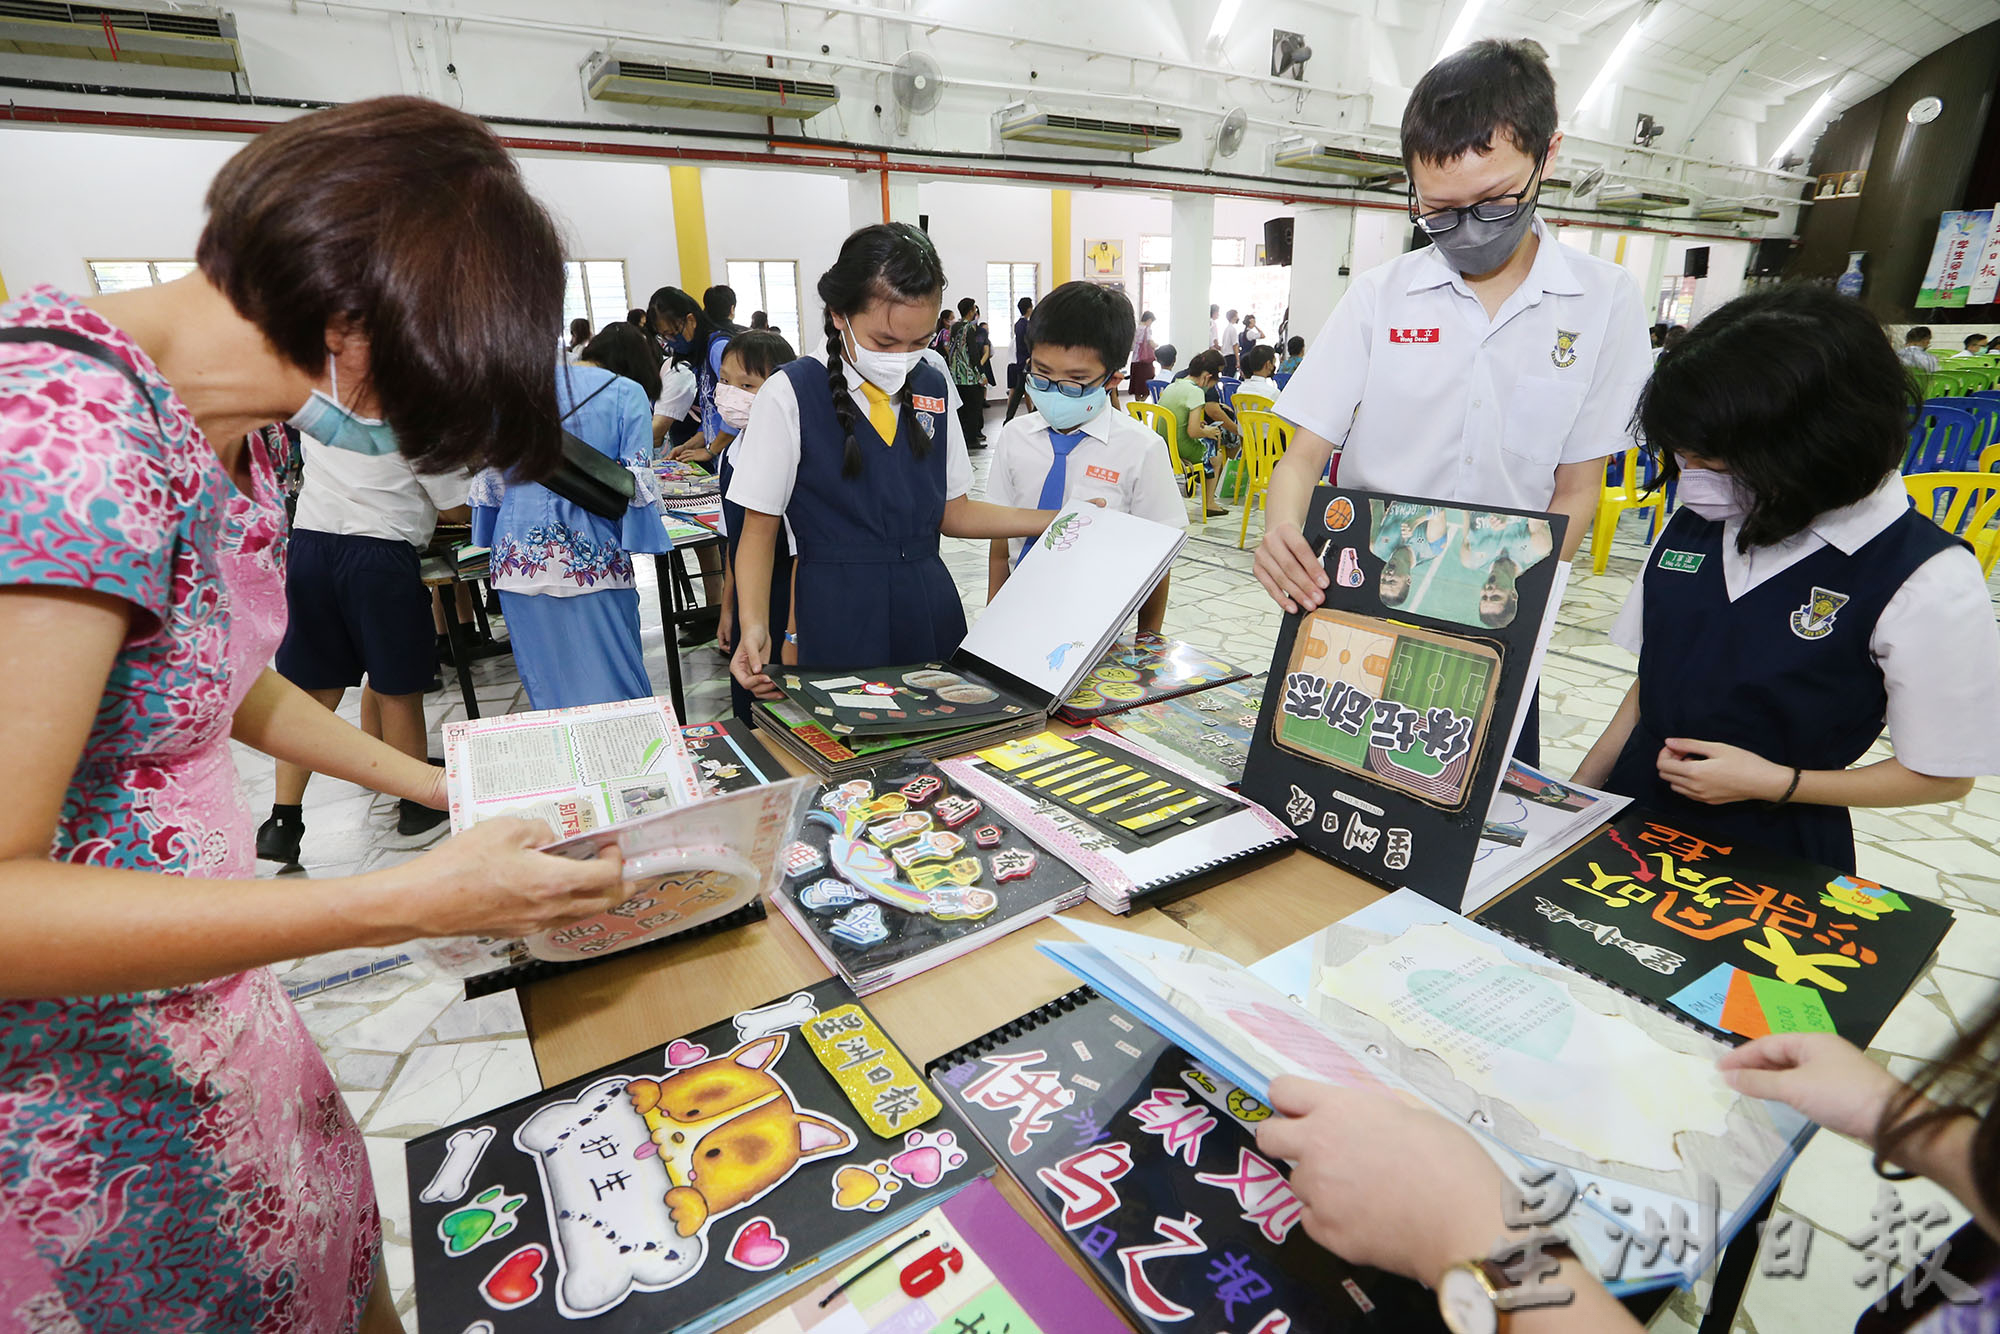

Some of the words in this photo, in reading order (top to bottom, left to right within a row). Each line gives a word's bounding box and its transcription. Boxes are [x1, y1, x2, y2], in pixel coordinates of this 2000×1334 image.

[1283, 672, 1474, 765] 体坛动态
[1286, 784, 1413, 871] 星洲日报
[1535, 895, 1687, 976] 星洲日报
[813, 1012, 922, 1128] 星洲日报
[580, 1134, 633, 1201] 护生
[899, 1245, 964, 1298] 6
